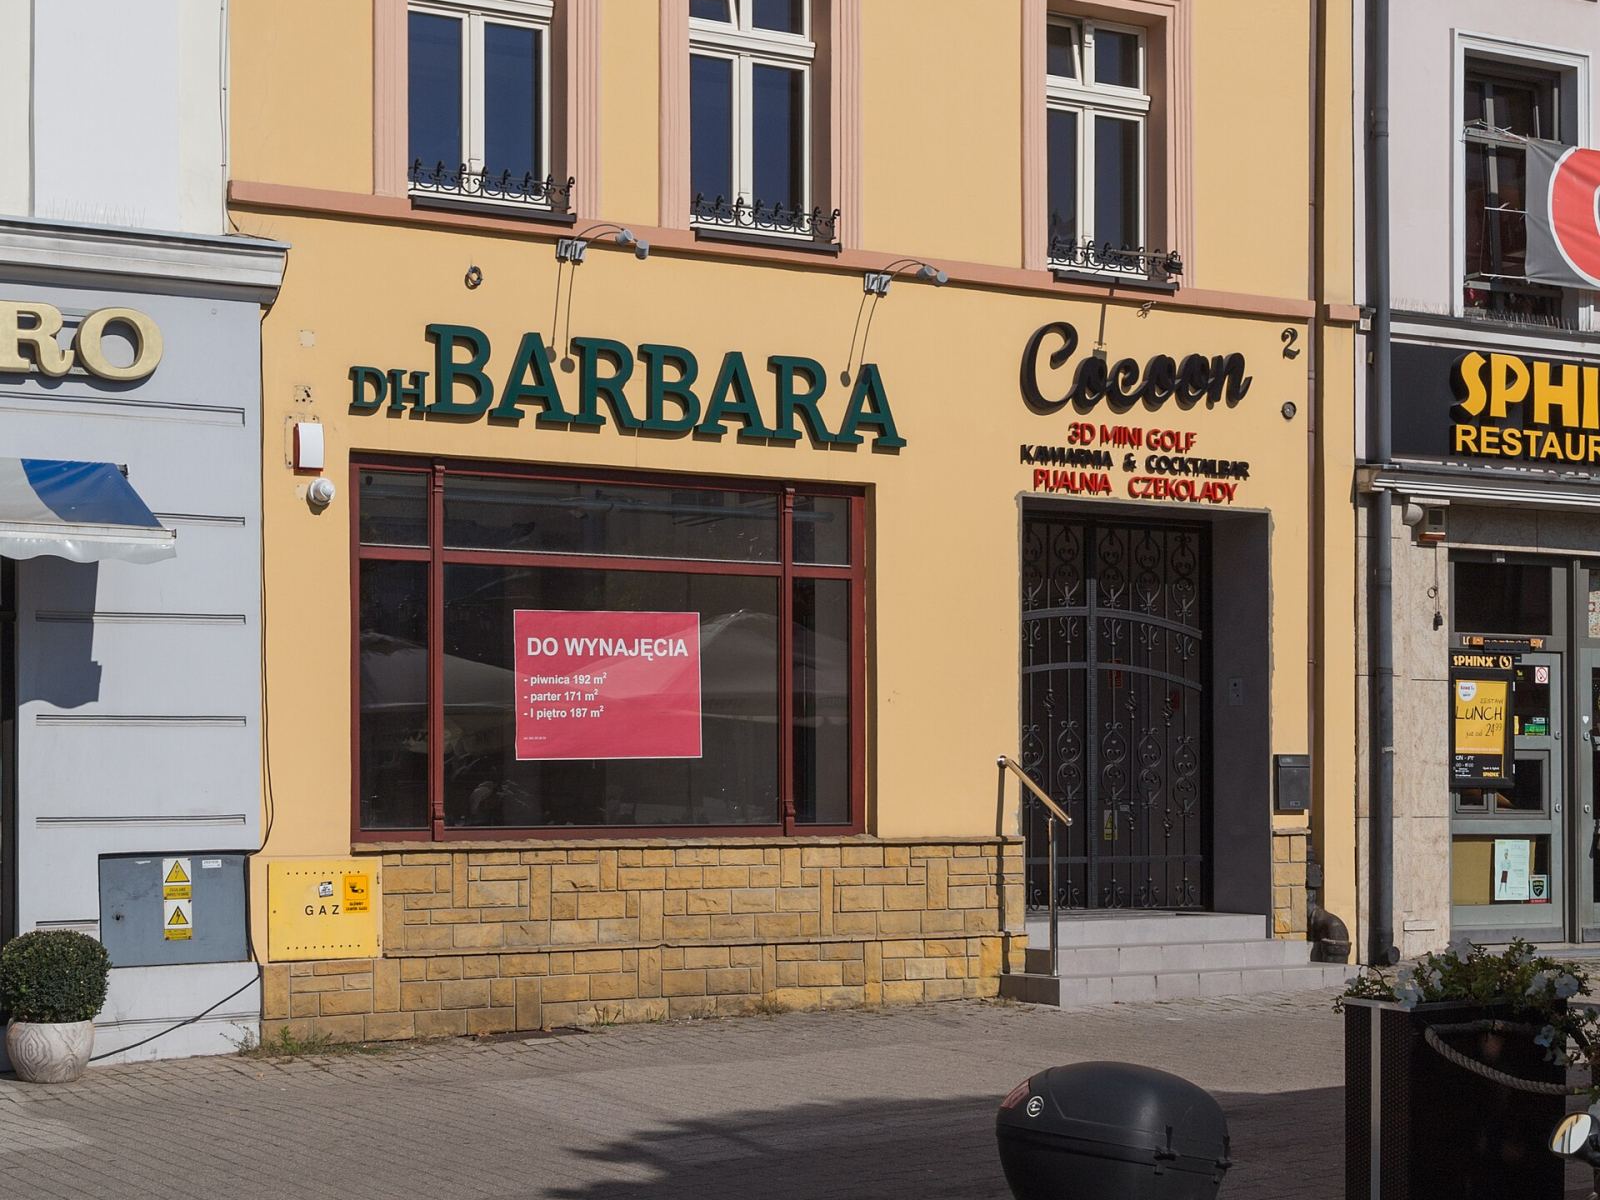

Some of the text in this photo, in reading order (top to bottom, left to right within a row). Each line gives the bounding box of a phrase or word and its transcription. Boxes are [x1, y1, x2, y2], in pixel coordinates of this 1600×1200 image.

[1281, 327, 1300, 359] 2
[1020, 321, 1253, 415] Cocoon
[425, 324, 907, 449] BARBARA
[1067, 422, 1198, 455] 3D MINI GOLF
[1122, 452, 1138, 473] &
[1033, 468, 1238, 504] PIJALNIA CZEKOLADY
[527, 637, 689, 661] DO WYNAJĘCIA
[1453, 655, 1494, 667] SPHINX
[530, 674, 570, 686] piwnica
[572, 674, 591, 684] 192
[530, 692, 561, 703] parter
[564, 692, 582, 701] 171
[536, 708, 567, 720] piętro
[570, 708, 588, 718] 187
[1455, 706, 1502, 720] LUNCH
[305, 905, 340, 915] GAZ
